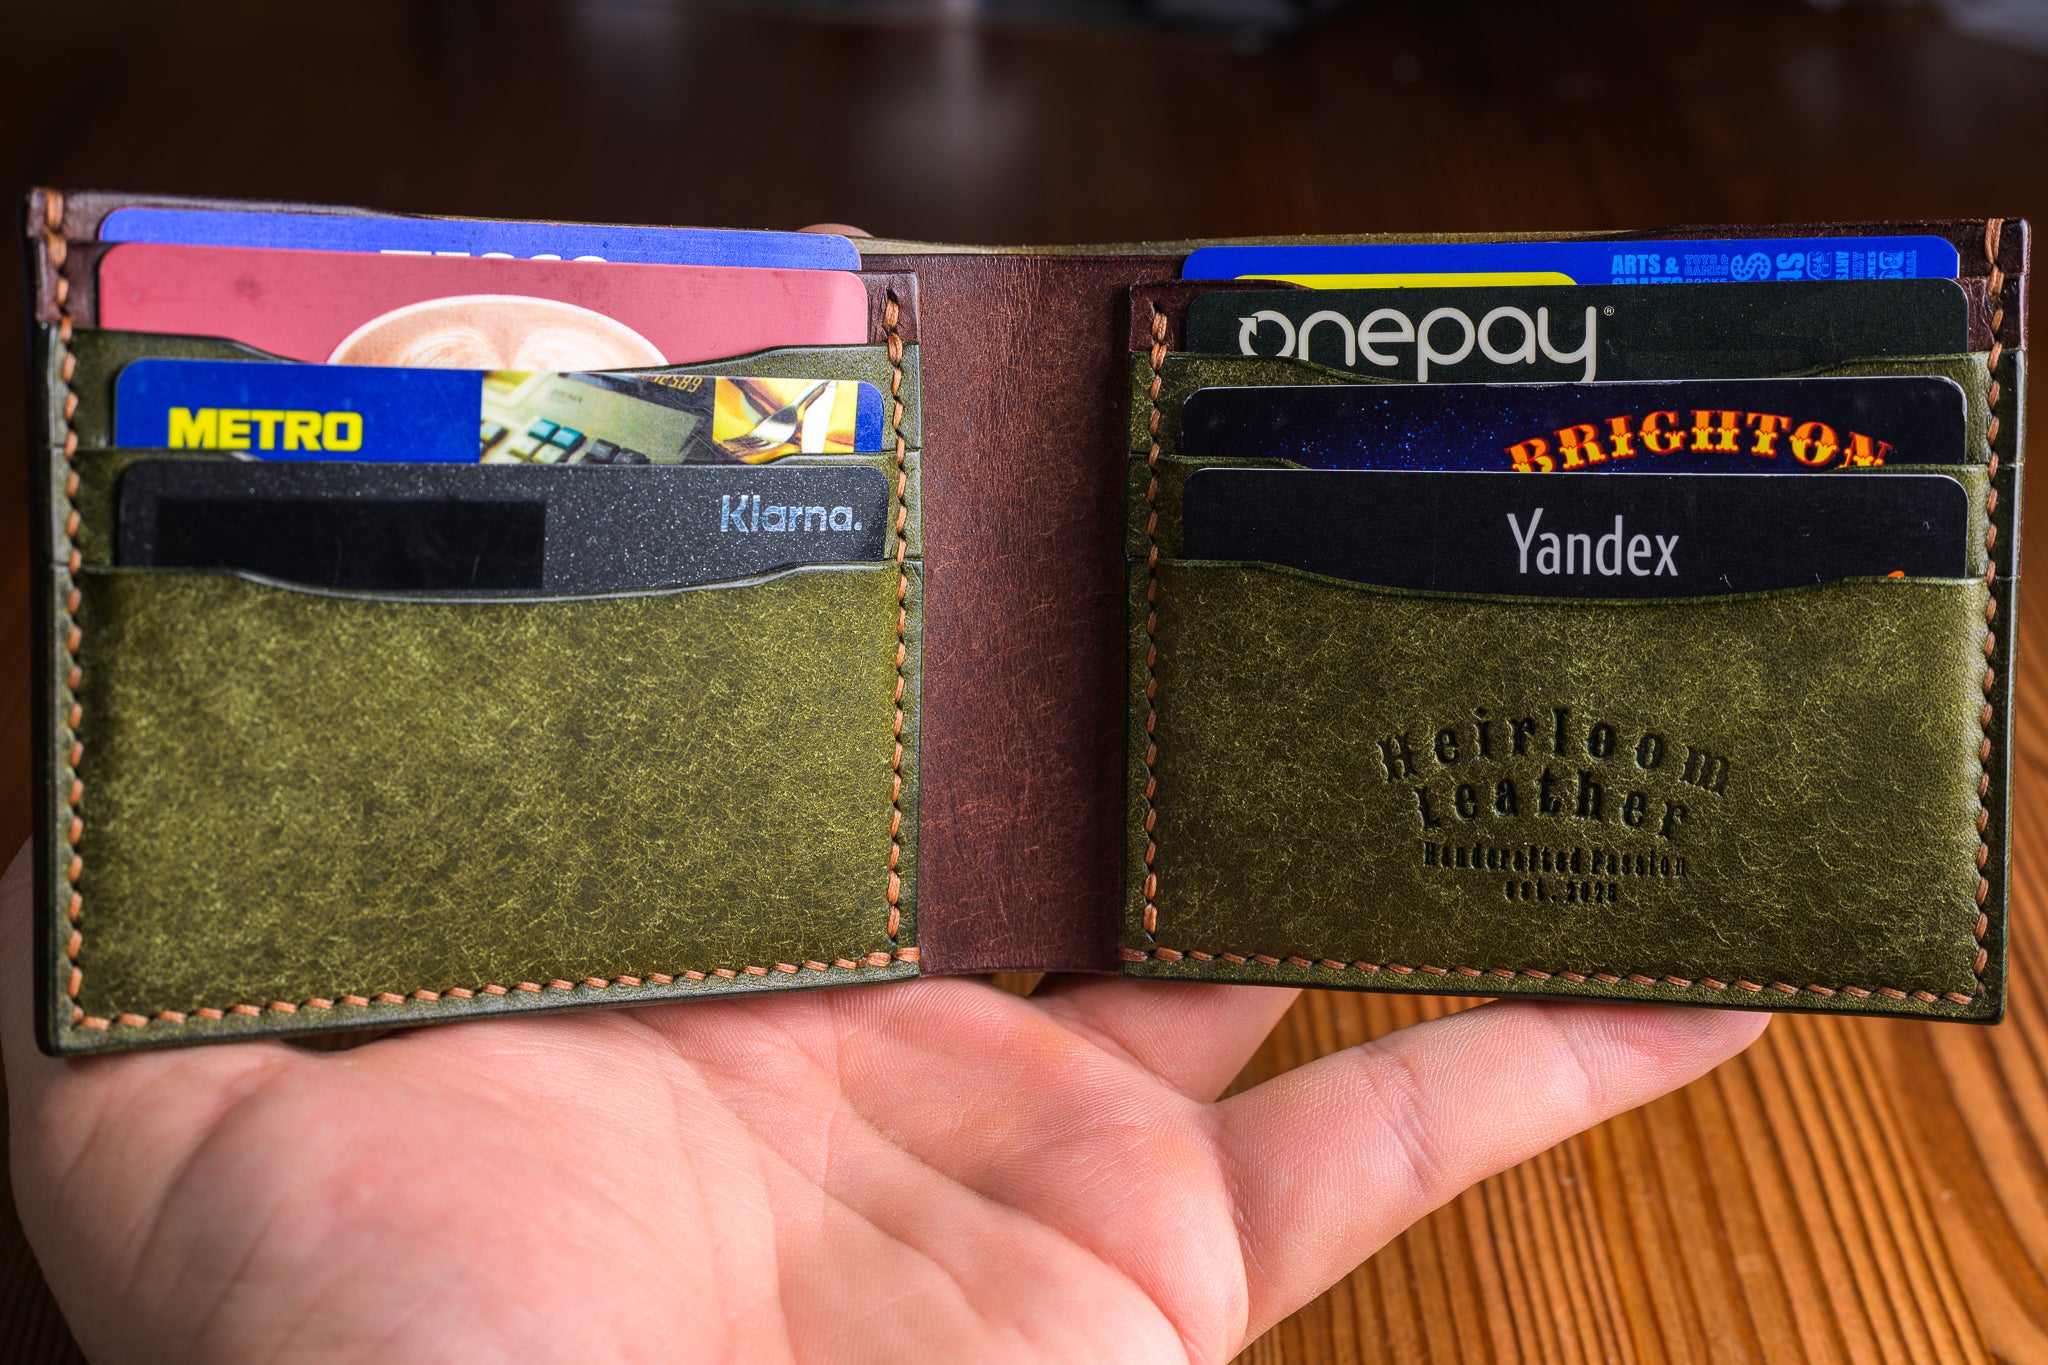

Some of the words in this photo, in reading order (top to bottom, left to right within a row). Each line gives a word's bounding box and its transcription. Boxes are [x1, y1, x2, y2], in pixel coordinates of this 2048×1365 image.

[1611, 254, 1661, 275] ARTS
[1665, 257, 1679, 274] &
[1684, 254, 1718, 265] TOYS
[1684, 265, 1729, 276] GAMES
[168, 407, 363, 451] METRO
[1504, 409, 1893, 473] BRIGHTON
[720, 494, 862, 532] Klarna.
[1506, 507, 1679, 576] Yandex
[1376, 707, 1730, 796] Heirloom
[1413, 768, 1688, 840] Leather
[1423, 842, 1581, 875] Handcrafted
[1590, 847, 1686, 877] Passion
